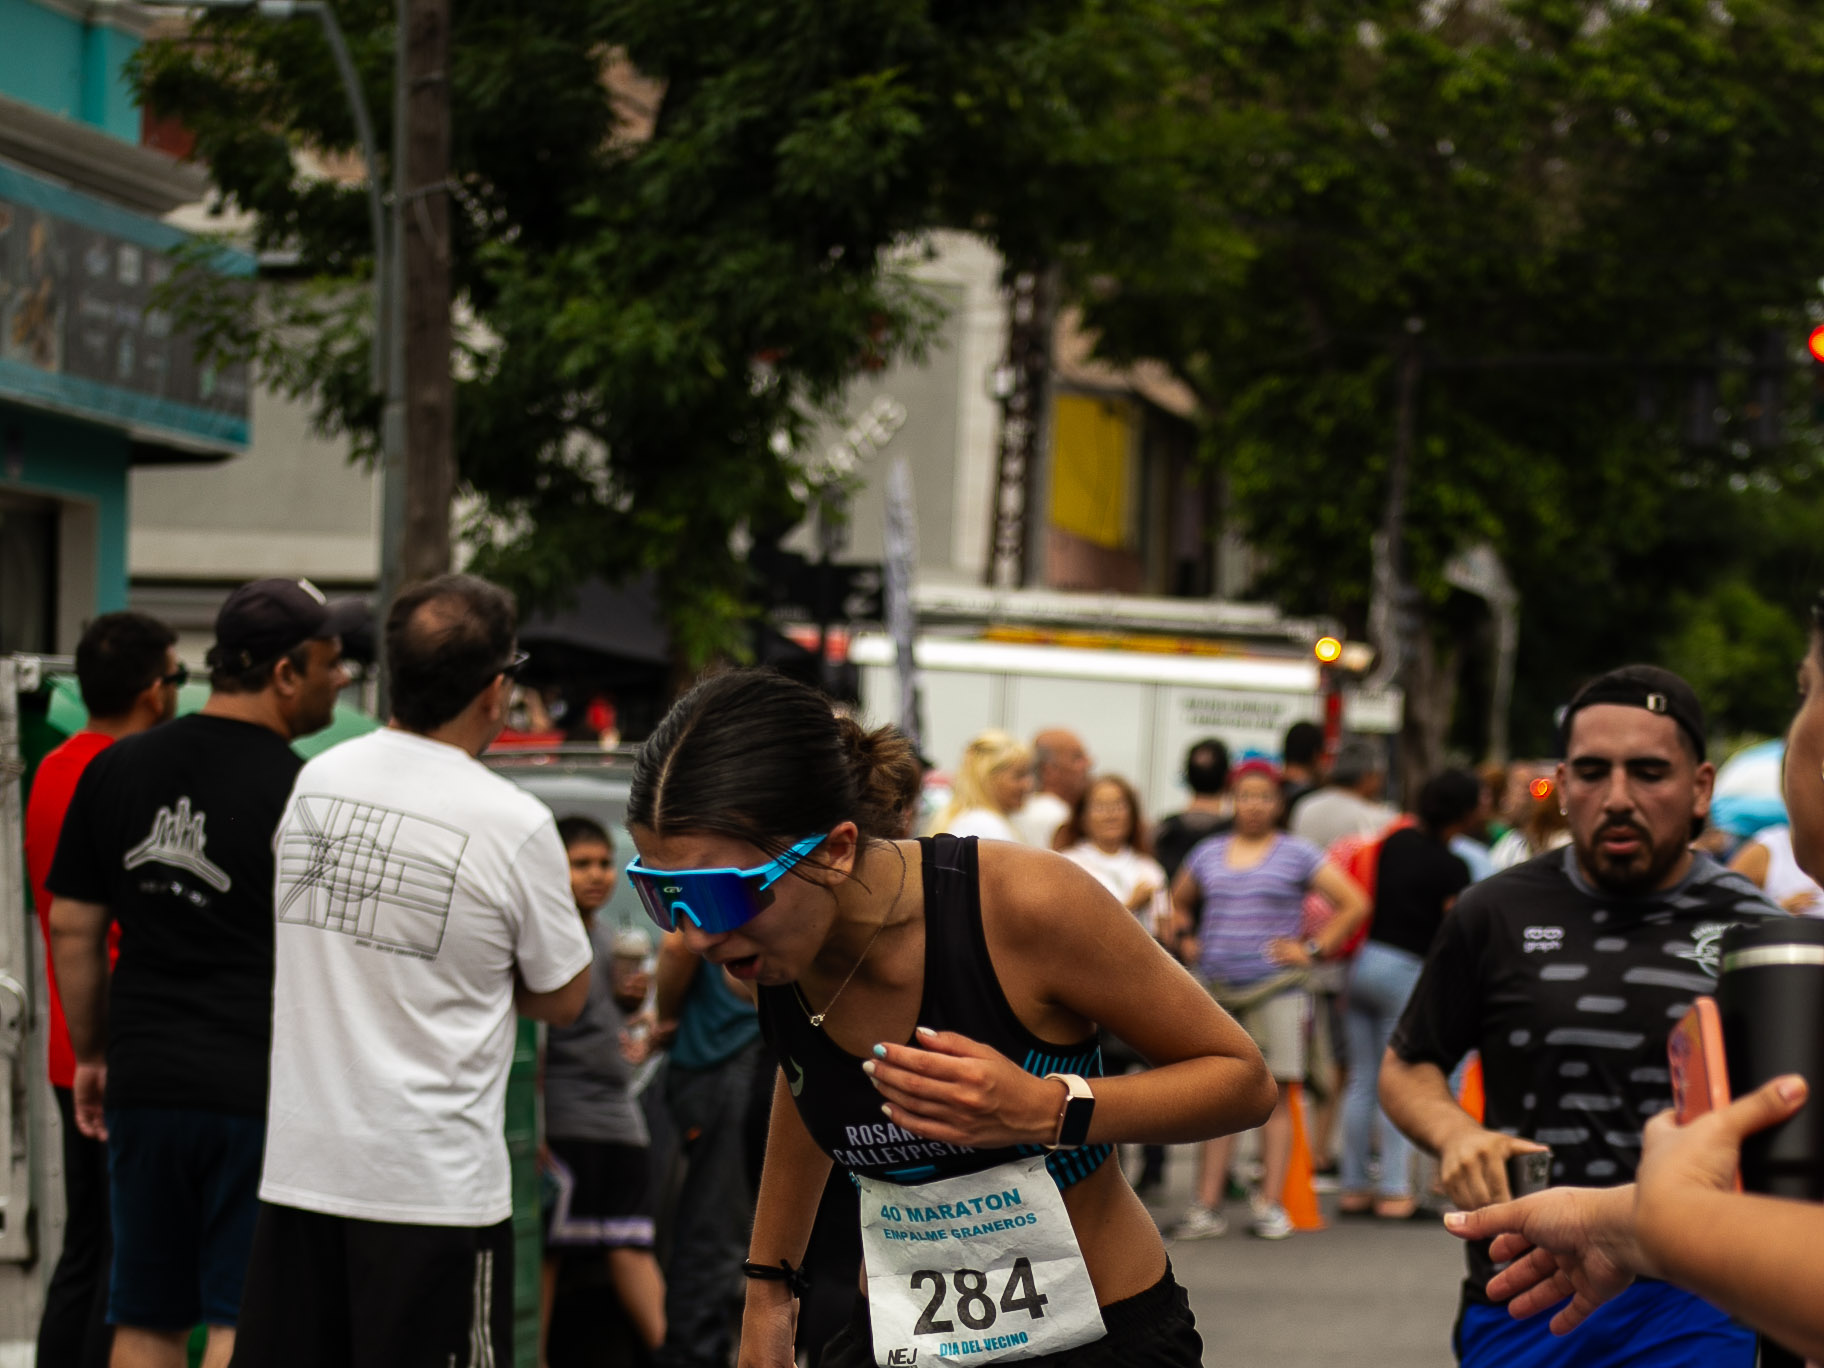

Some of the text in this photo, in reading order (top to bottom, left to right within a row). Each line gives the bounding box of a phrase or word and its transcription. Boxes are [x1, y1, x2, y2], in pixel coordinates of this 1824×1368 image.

[845, 1122, 924, 1146] ROSA
[880, 1187, 1023, 1223] 40 MARATON
[883, 1212, 1038, 1242] EMPALME GRANEROS
[909, 1256, 1049, 1336] 284
[939, 1331, 1029, 1357] DIA DEL VECINO
